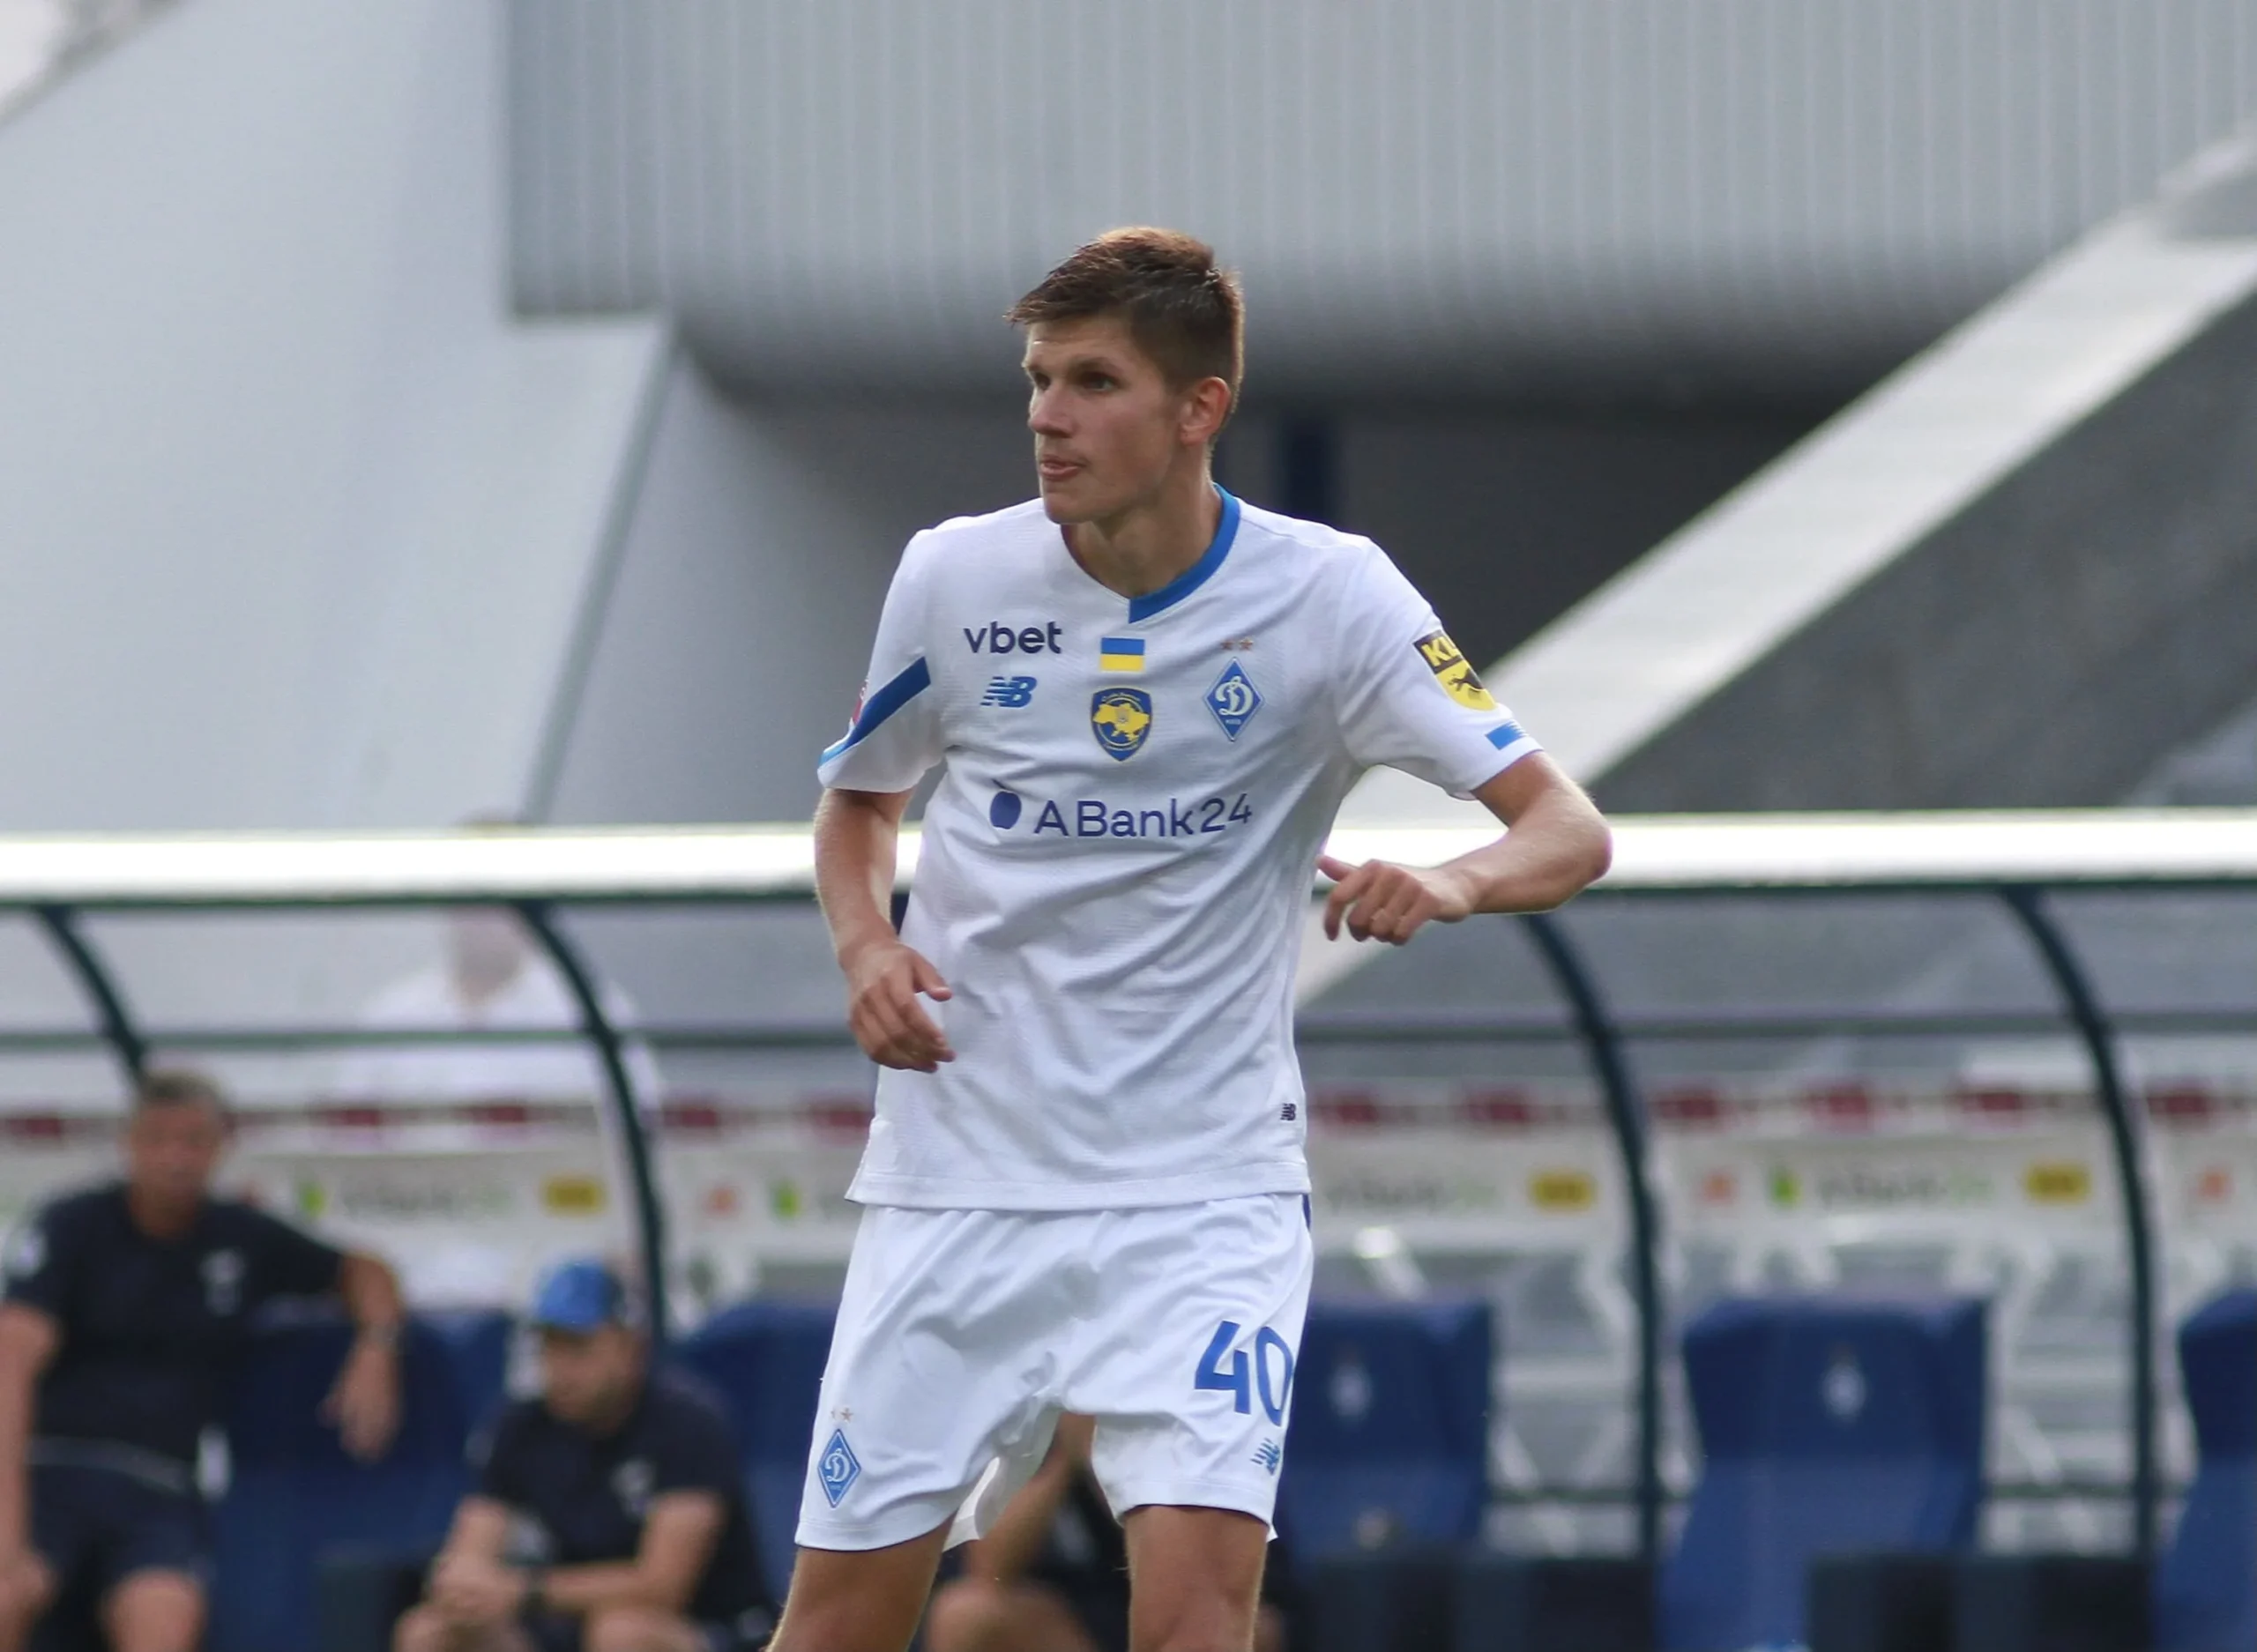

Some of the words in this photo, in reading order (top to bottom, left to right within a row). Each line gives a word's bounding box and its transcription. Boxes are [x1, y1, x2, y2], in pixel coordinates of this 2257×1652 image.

[964, 621, 1063, 653] vbet
[1421, 636, 1461, 667] KL
[1195, 1320, 1293, 1427] 40
